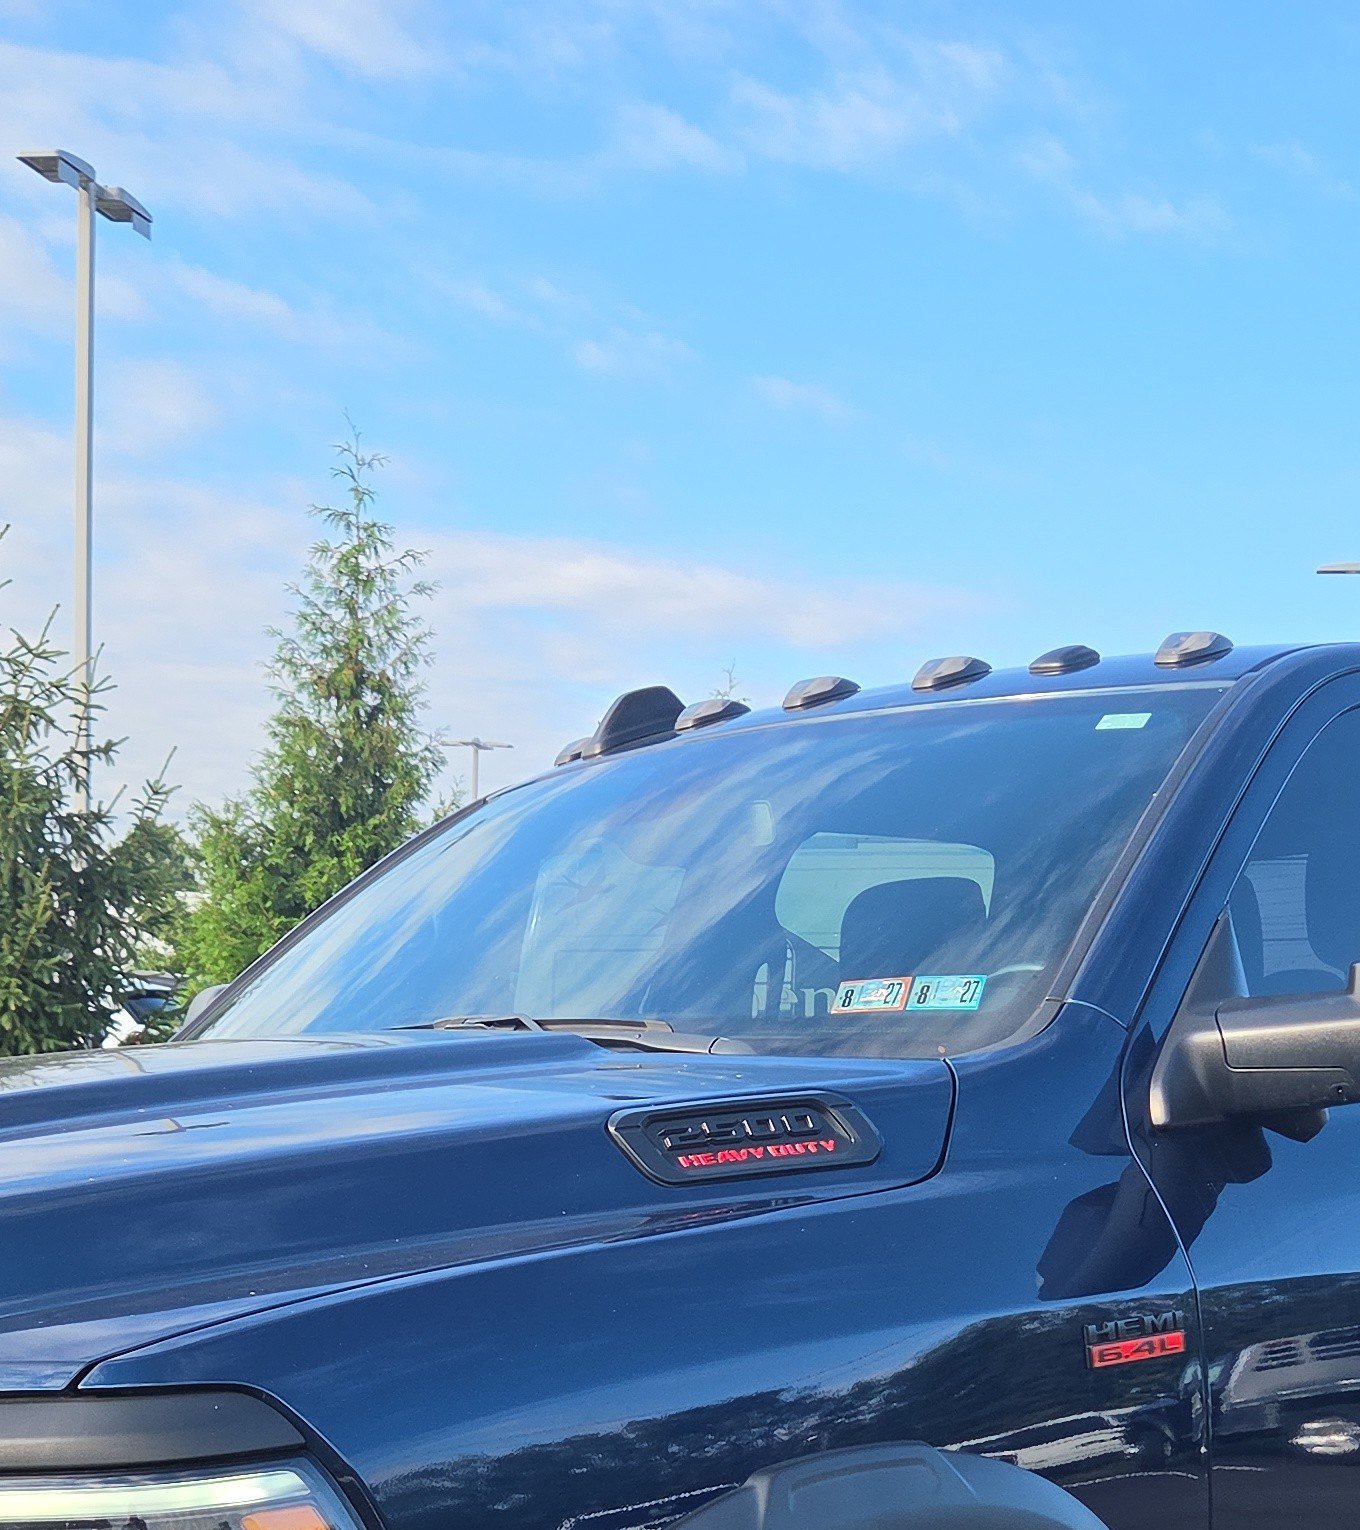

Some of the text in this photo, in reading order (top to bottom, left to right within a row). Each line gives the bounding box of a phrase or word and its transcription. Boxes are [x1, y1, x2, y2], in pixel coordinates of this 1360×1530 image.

[842, 982, 903, 1008] 8 27
[916, 980, 981, 1004] 8 27
[658, 1113, 823, 1151] 2500
[677, 1139, 836, 1168] HEAVY DUTY
[1086, 1309, 1189, 1343] HEMI
[1097, 1336, 1181, 1364] 6.4L
